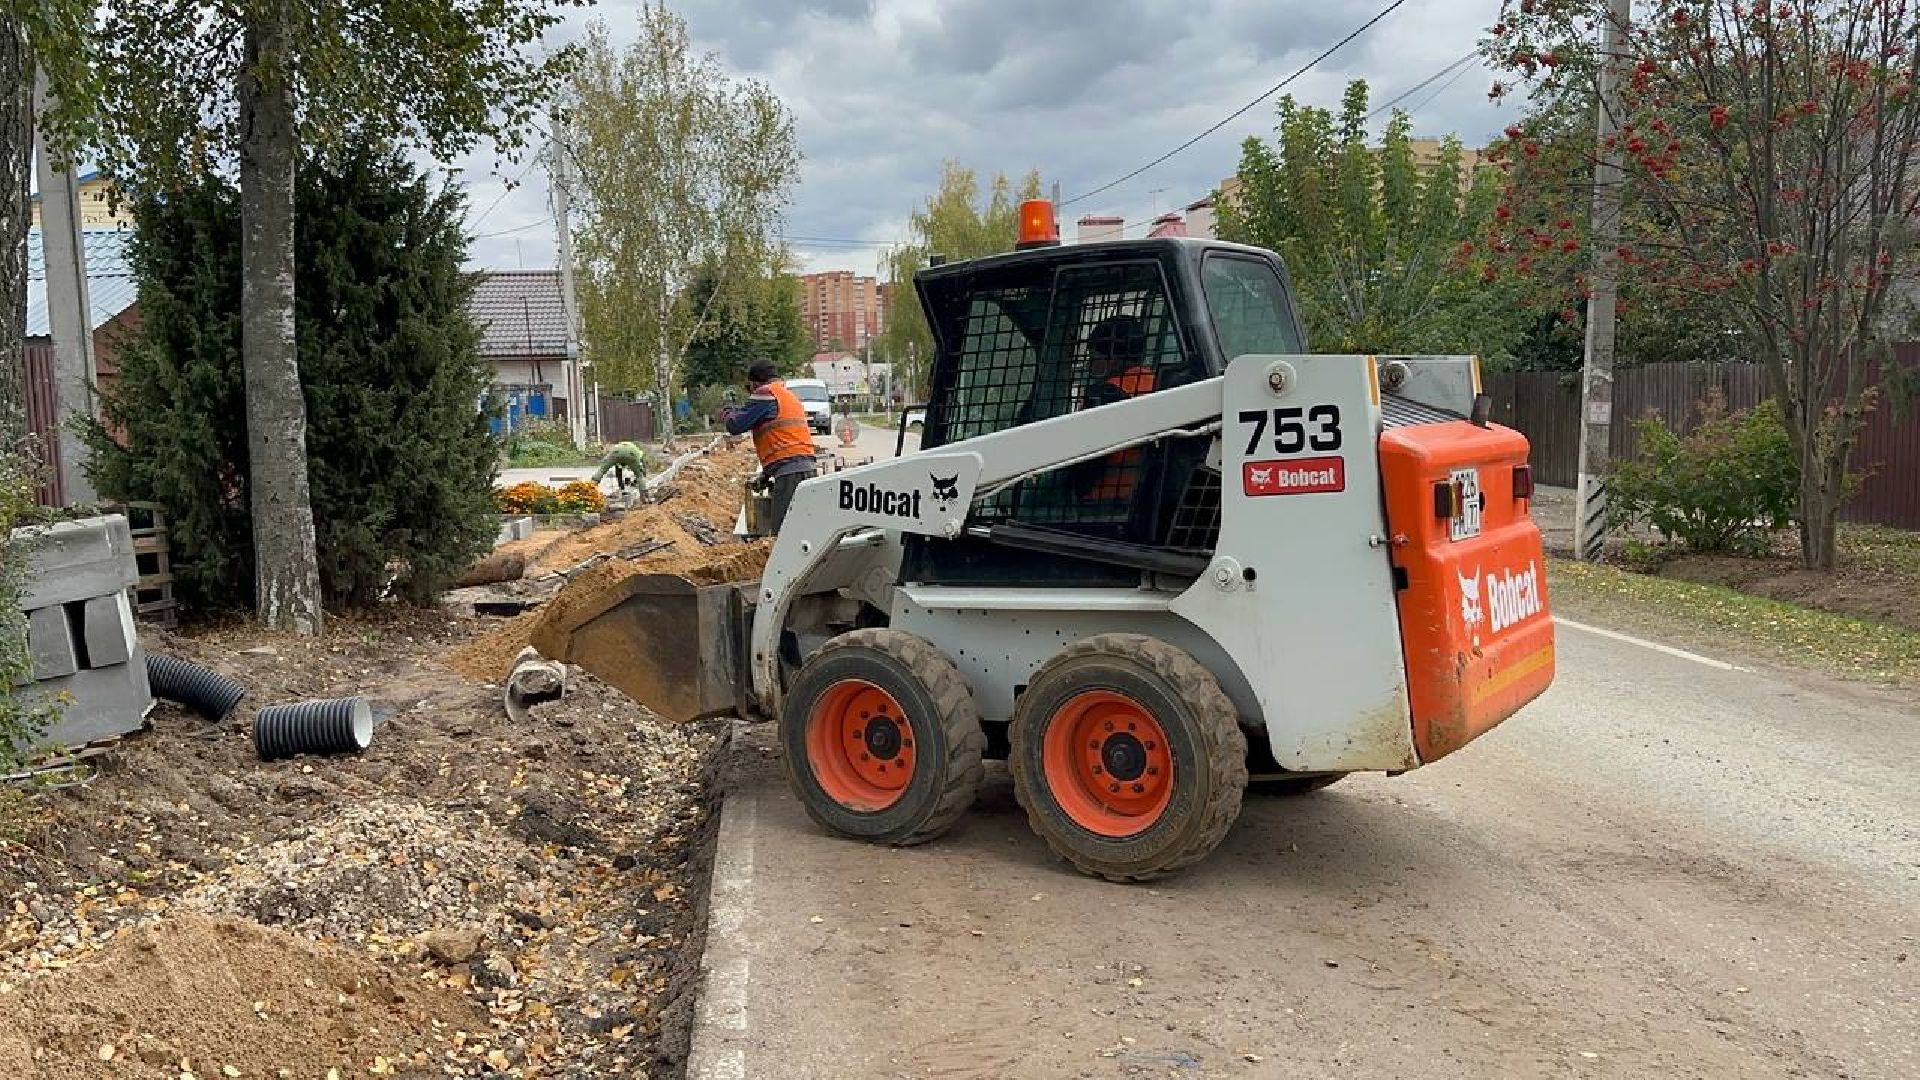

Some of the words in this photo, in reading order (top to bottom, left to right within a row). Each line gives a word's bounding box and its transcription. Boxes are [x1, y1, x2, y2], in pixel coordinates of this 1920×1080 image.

[1239, 405, 1342, 456] 753
[839, 480, 921, 519] Bobcat
[1278, 468, 1336, 487] Bobcat
[1486, 559, 1542, 633] Bobcat
